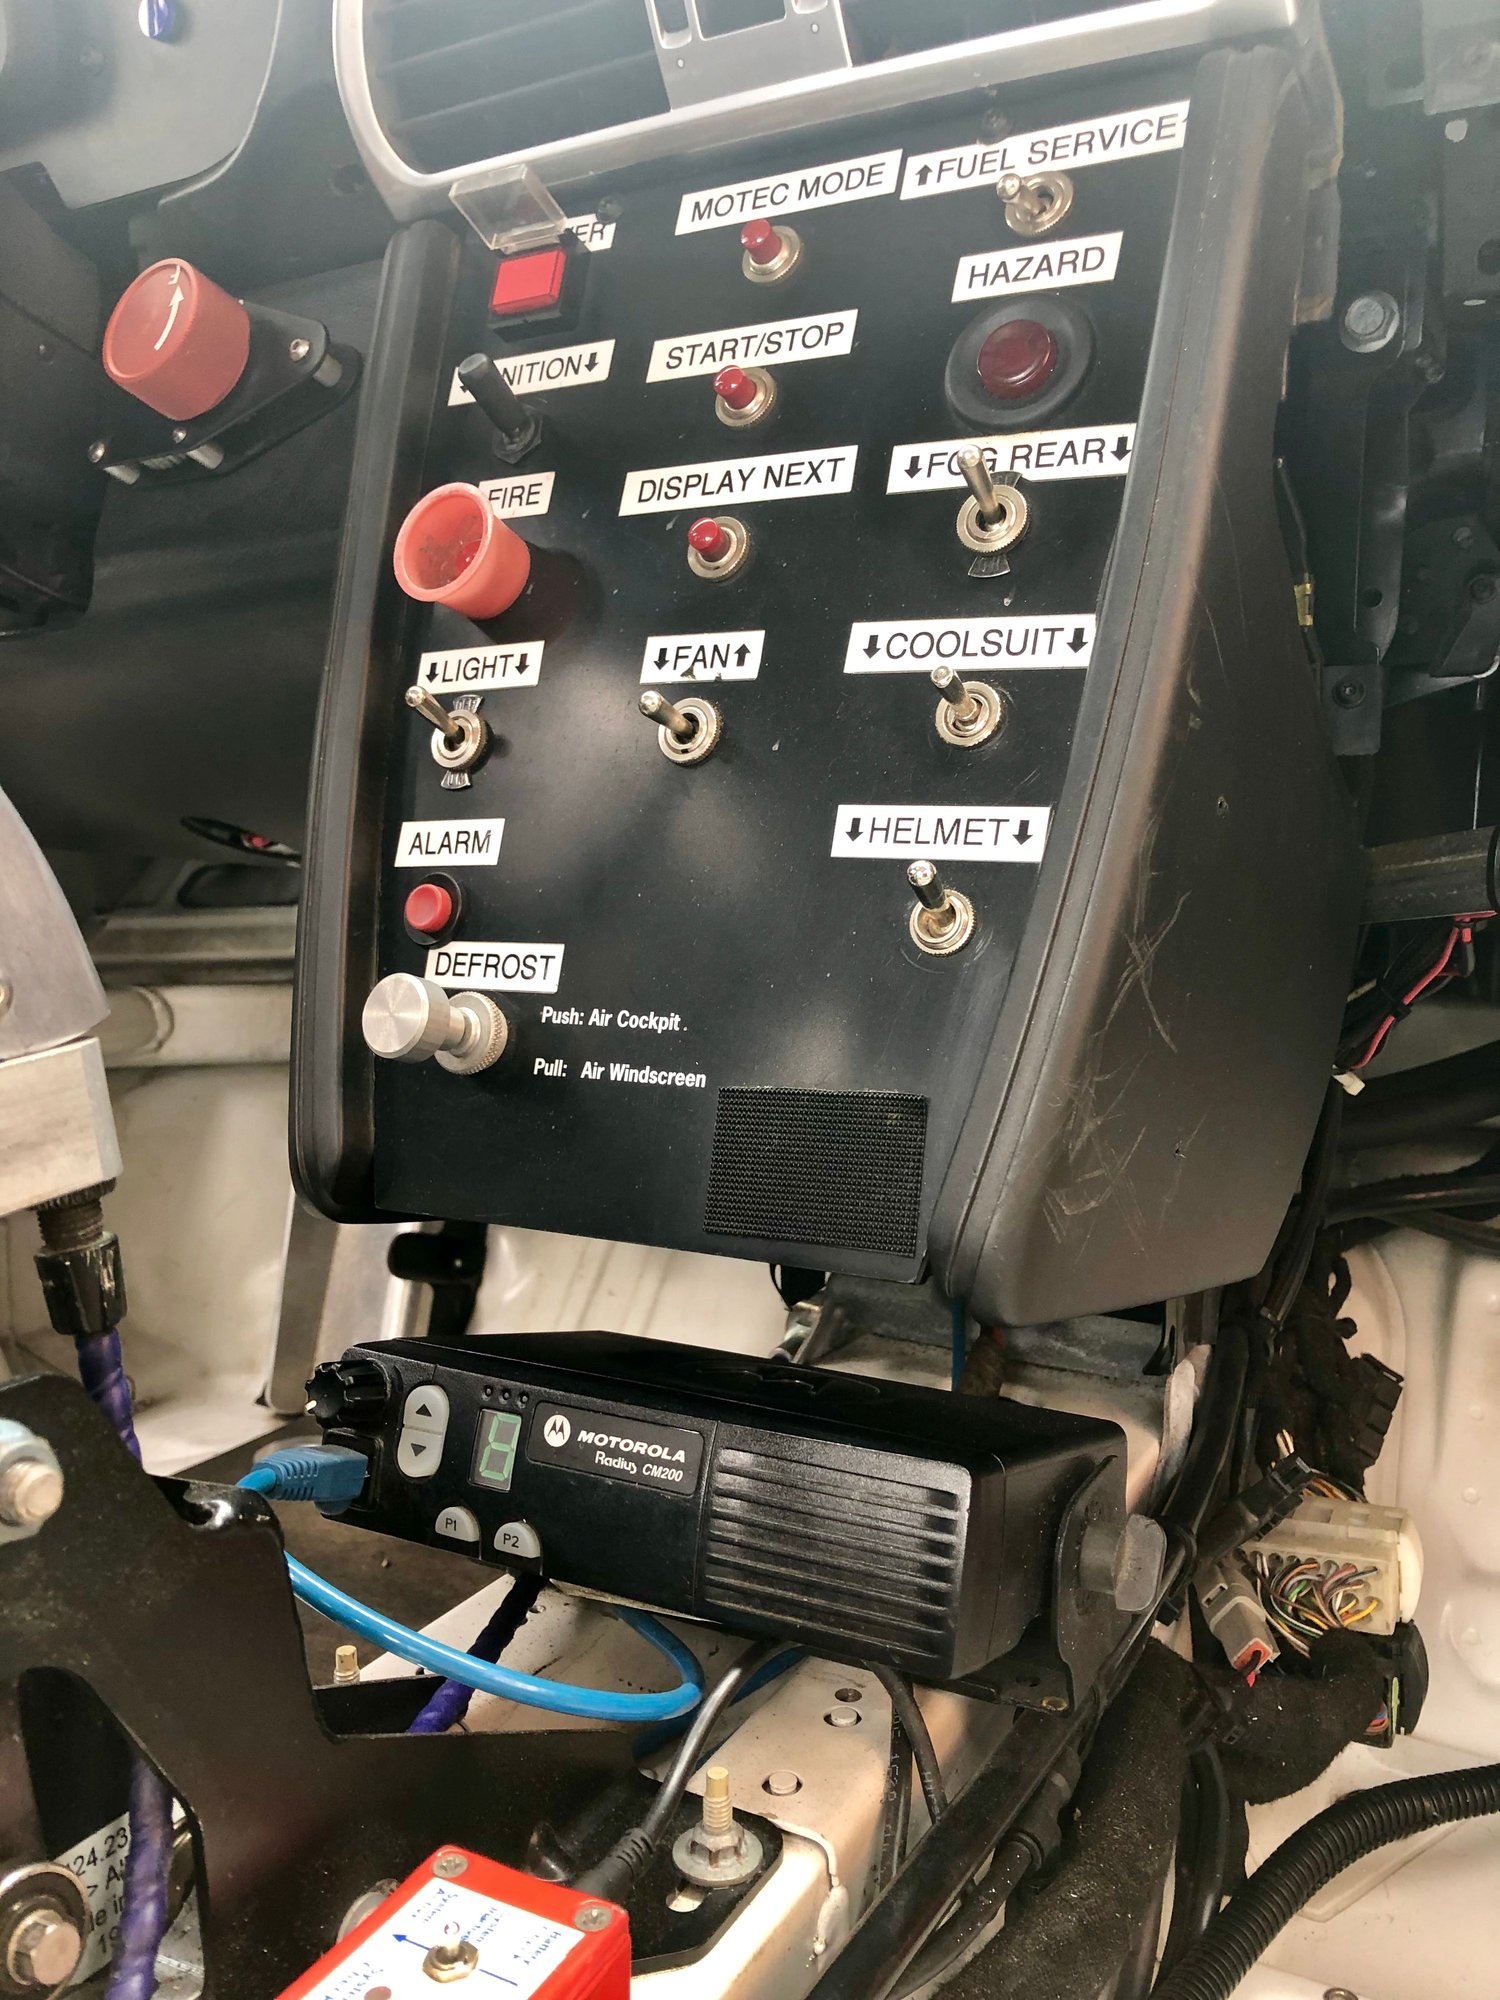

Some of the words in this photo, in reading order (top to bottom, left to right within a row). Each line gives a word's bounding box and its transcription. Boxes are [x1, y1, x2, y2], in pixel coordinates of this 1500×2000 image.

[936, 148, 1016, 184] FUEL
[1027, 113, 1179, 165] SERVICE
[691, 182, 790, 223] MOTEC
[797, 162, 887, 201] MODE
[968, 246, 1105, 289] HAZARD
[665, 321, 845, 370] START/STOP
[501, 354, 582, 387] NITION
[1009, 437, 1106, 471] REAR
[488, 482, 544, 510] FIRE
[637, 466, 756, 504] DISPLAY
[763, 457, 846, 490] NEXT
[673, 643, 731, 671] FAN
[885, 627, 1065, 660] COOLSUIT
[441, 653, 515, 683] LIGHT
[408, 829, 492, 856] ALARM
[868, 816, 1010, 846] HELMET
[434, 951, 556, 980] DEFROST
[540, 1005, 585, 1026] Push:
[588, 1008, 613, 1027] Air
[533, 1057, 568, 1078] Pull:
[580, 1060, 606, 1080] Air
[609, 1062, 707, 1089] Windscreen
[577, 1429, 686, 1464] MOTOROLA
[594, 1450, 638, 1476] Radius
[642, 1463, 684, 1483] CM200
[445, 1517, 458, 1532] P1
[503, 1533, 519, 1549] P2
[68, 1826, 129, 1876] 24.23
